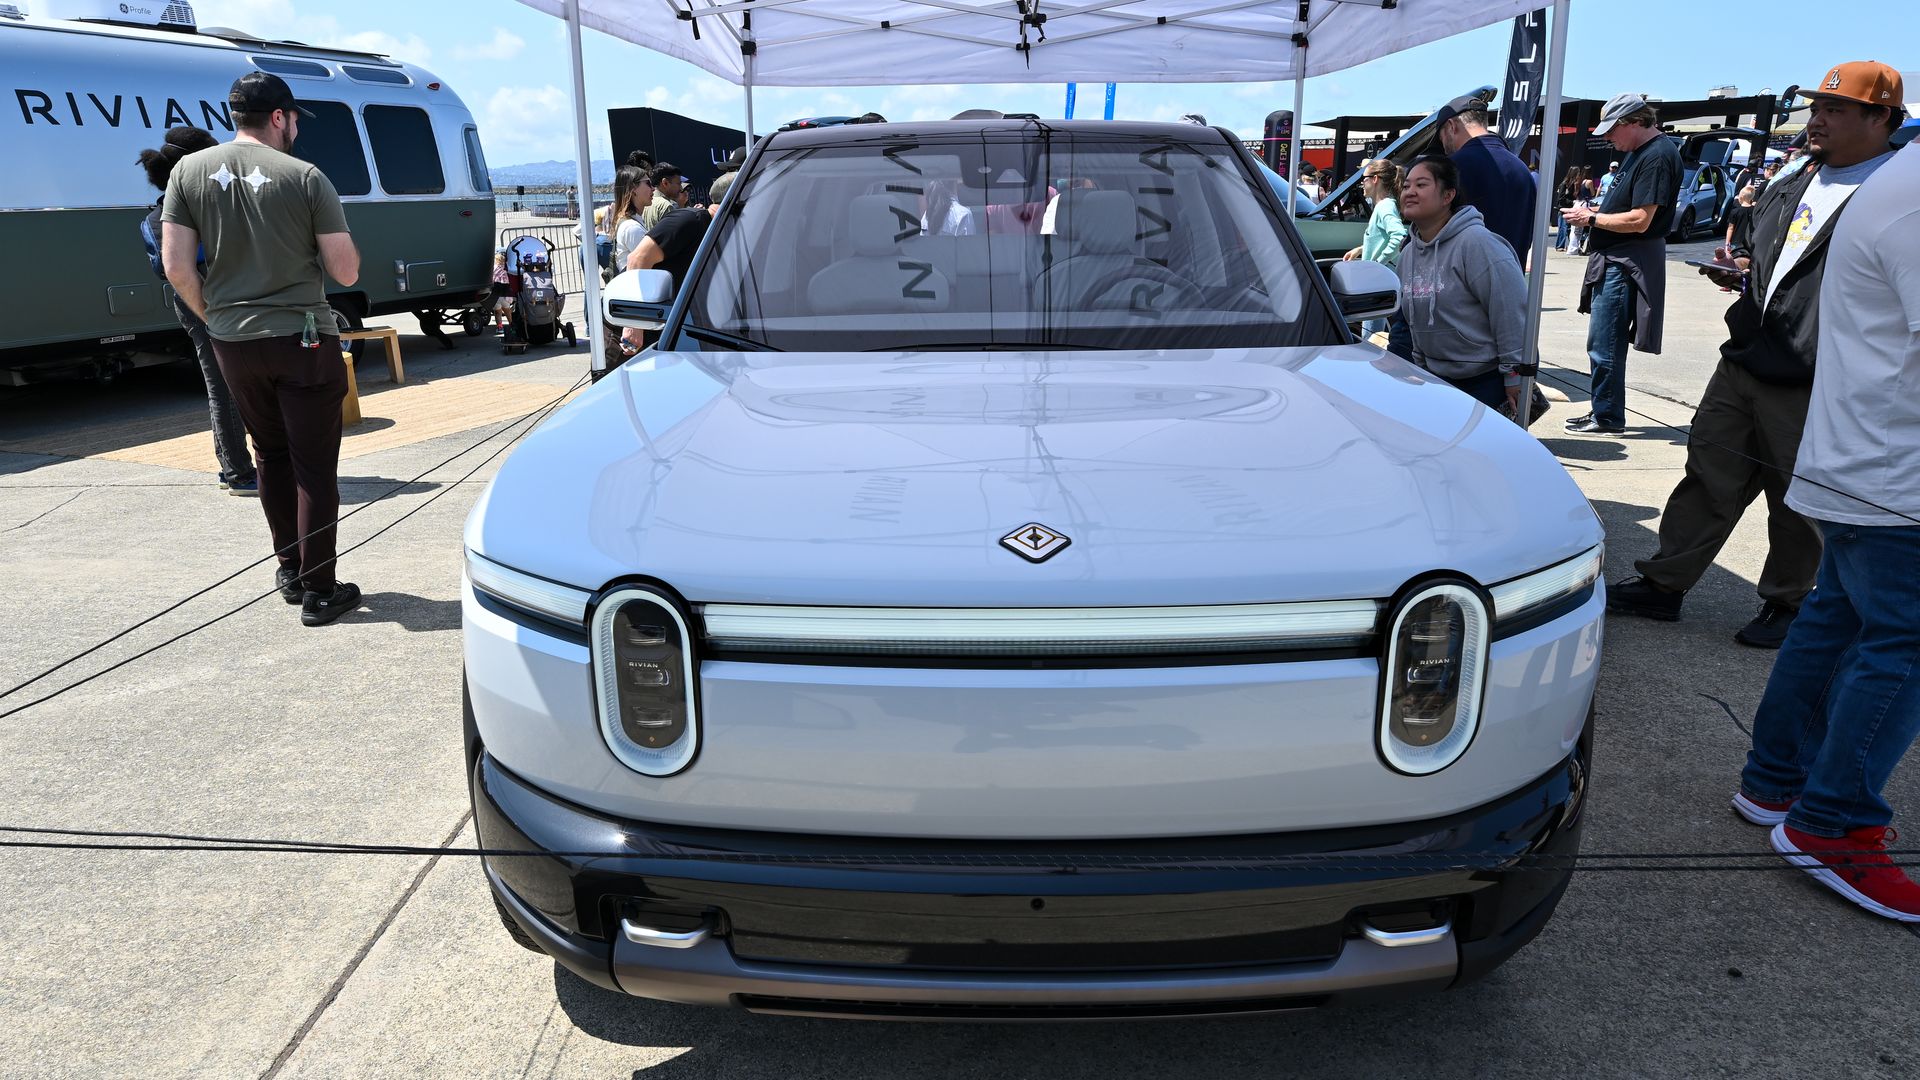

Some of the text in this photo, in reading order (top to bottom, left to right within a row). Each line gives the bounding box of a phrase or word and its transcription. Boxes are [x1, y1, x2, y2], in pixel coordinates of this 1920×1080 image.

[129, 6, 152, 15] Profile
[1826, 69, 1842, 89] LA
[14, 89, 235, 132] RIVIAN
